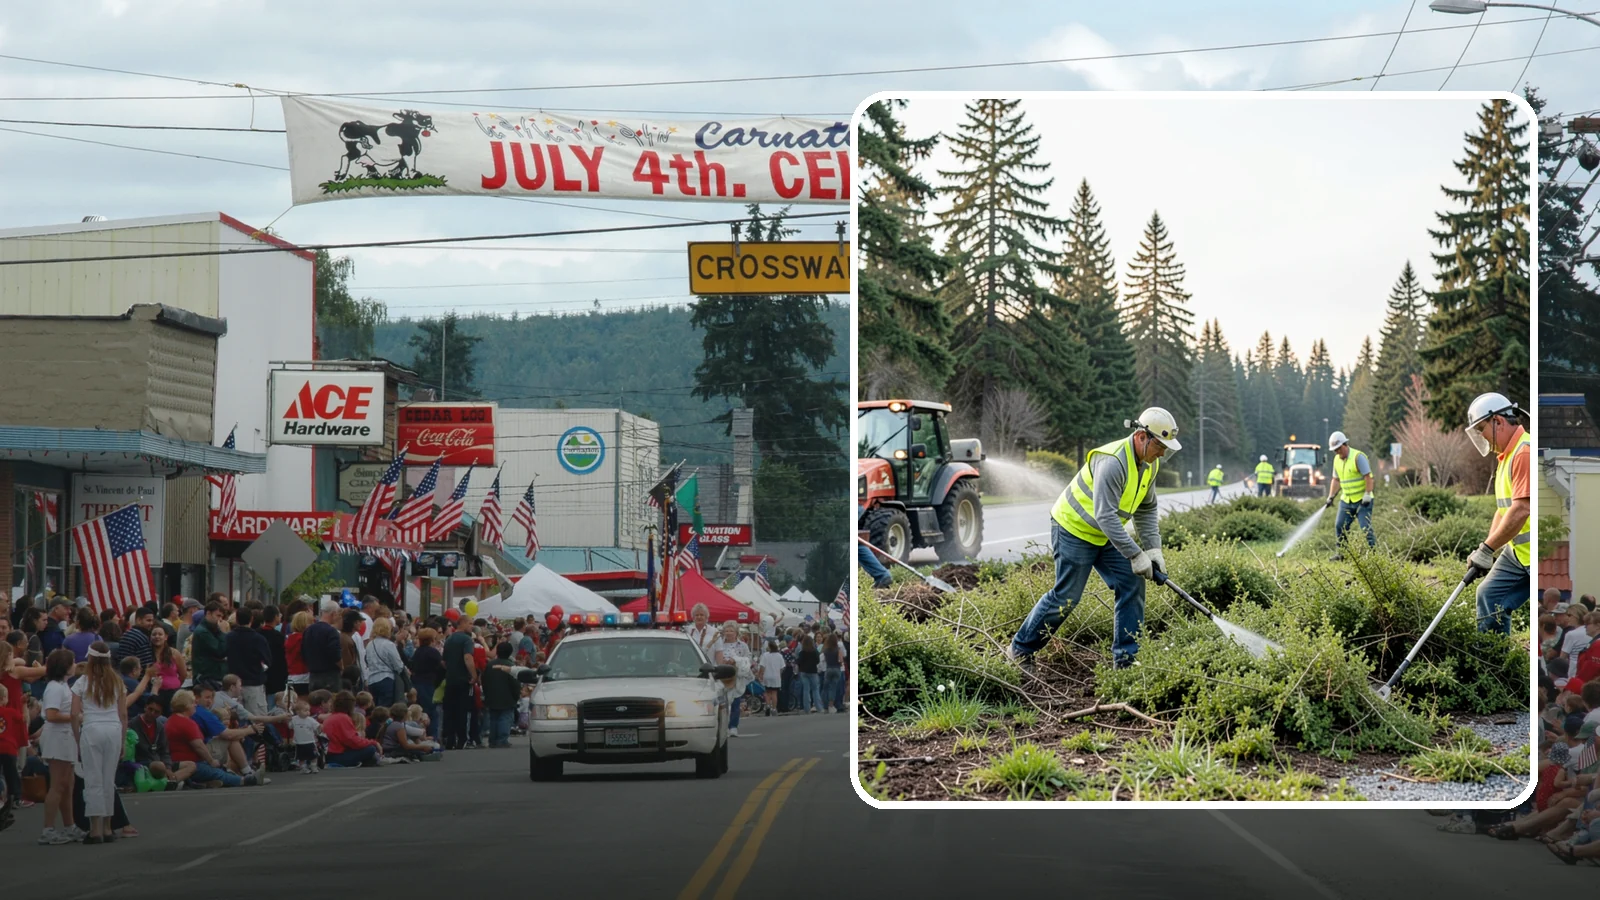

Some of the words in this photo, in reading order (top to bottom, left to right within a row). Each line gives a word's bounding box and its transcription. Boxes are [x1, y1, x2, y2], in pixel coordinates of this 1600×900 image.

[481, 140, 605, 192] JULY
[632, 149, 747, 198] 4th.
[696, 254, 850, 280] CROSSWA
[282, 380, 374, 420] ACE
[405, 409, 453, 422] CEDAR
[283, 420, 371, 436] Hardware
[83, 485, 93, 495] St.
[95, 484, 124, 495] Vincent
[126, 485, 136, 495] de
[137, 485, 155, 496] Paul
[212, 515, 331, 536] HARDARE
[688, 526, 742, 535] CRNATION
[699, 535, 730, 544] GLASS
